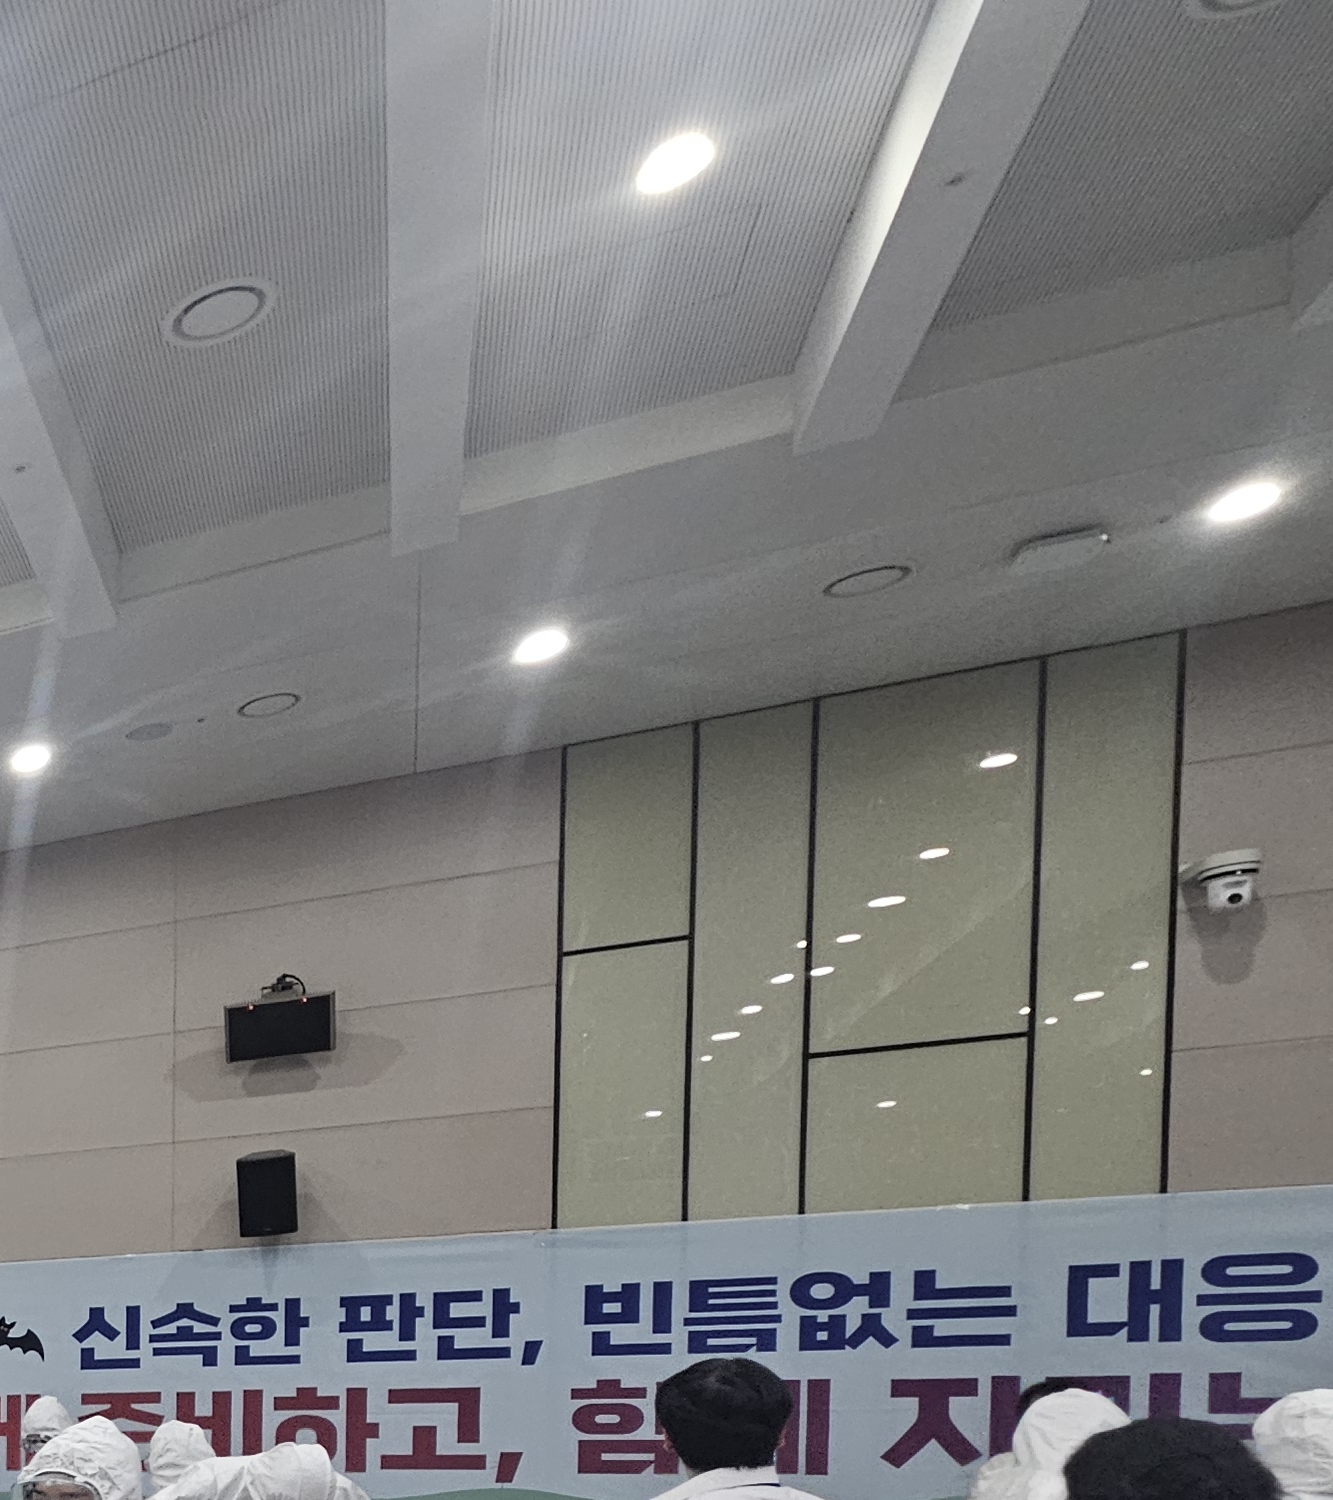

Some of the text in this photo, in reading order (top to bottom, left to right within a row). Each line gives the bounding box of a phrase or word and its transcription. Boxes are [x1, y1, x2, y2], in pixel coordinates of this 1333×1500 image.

[72, 1251, 1323, 1371] 신속한 판단, 빈틈없는 대응
